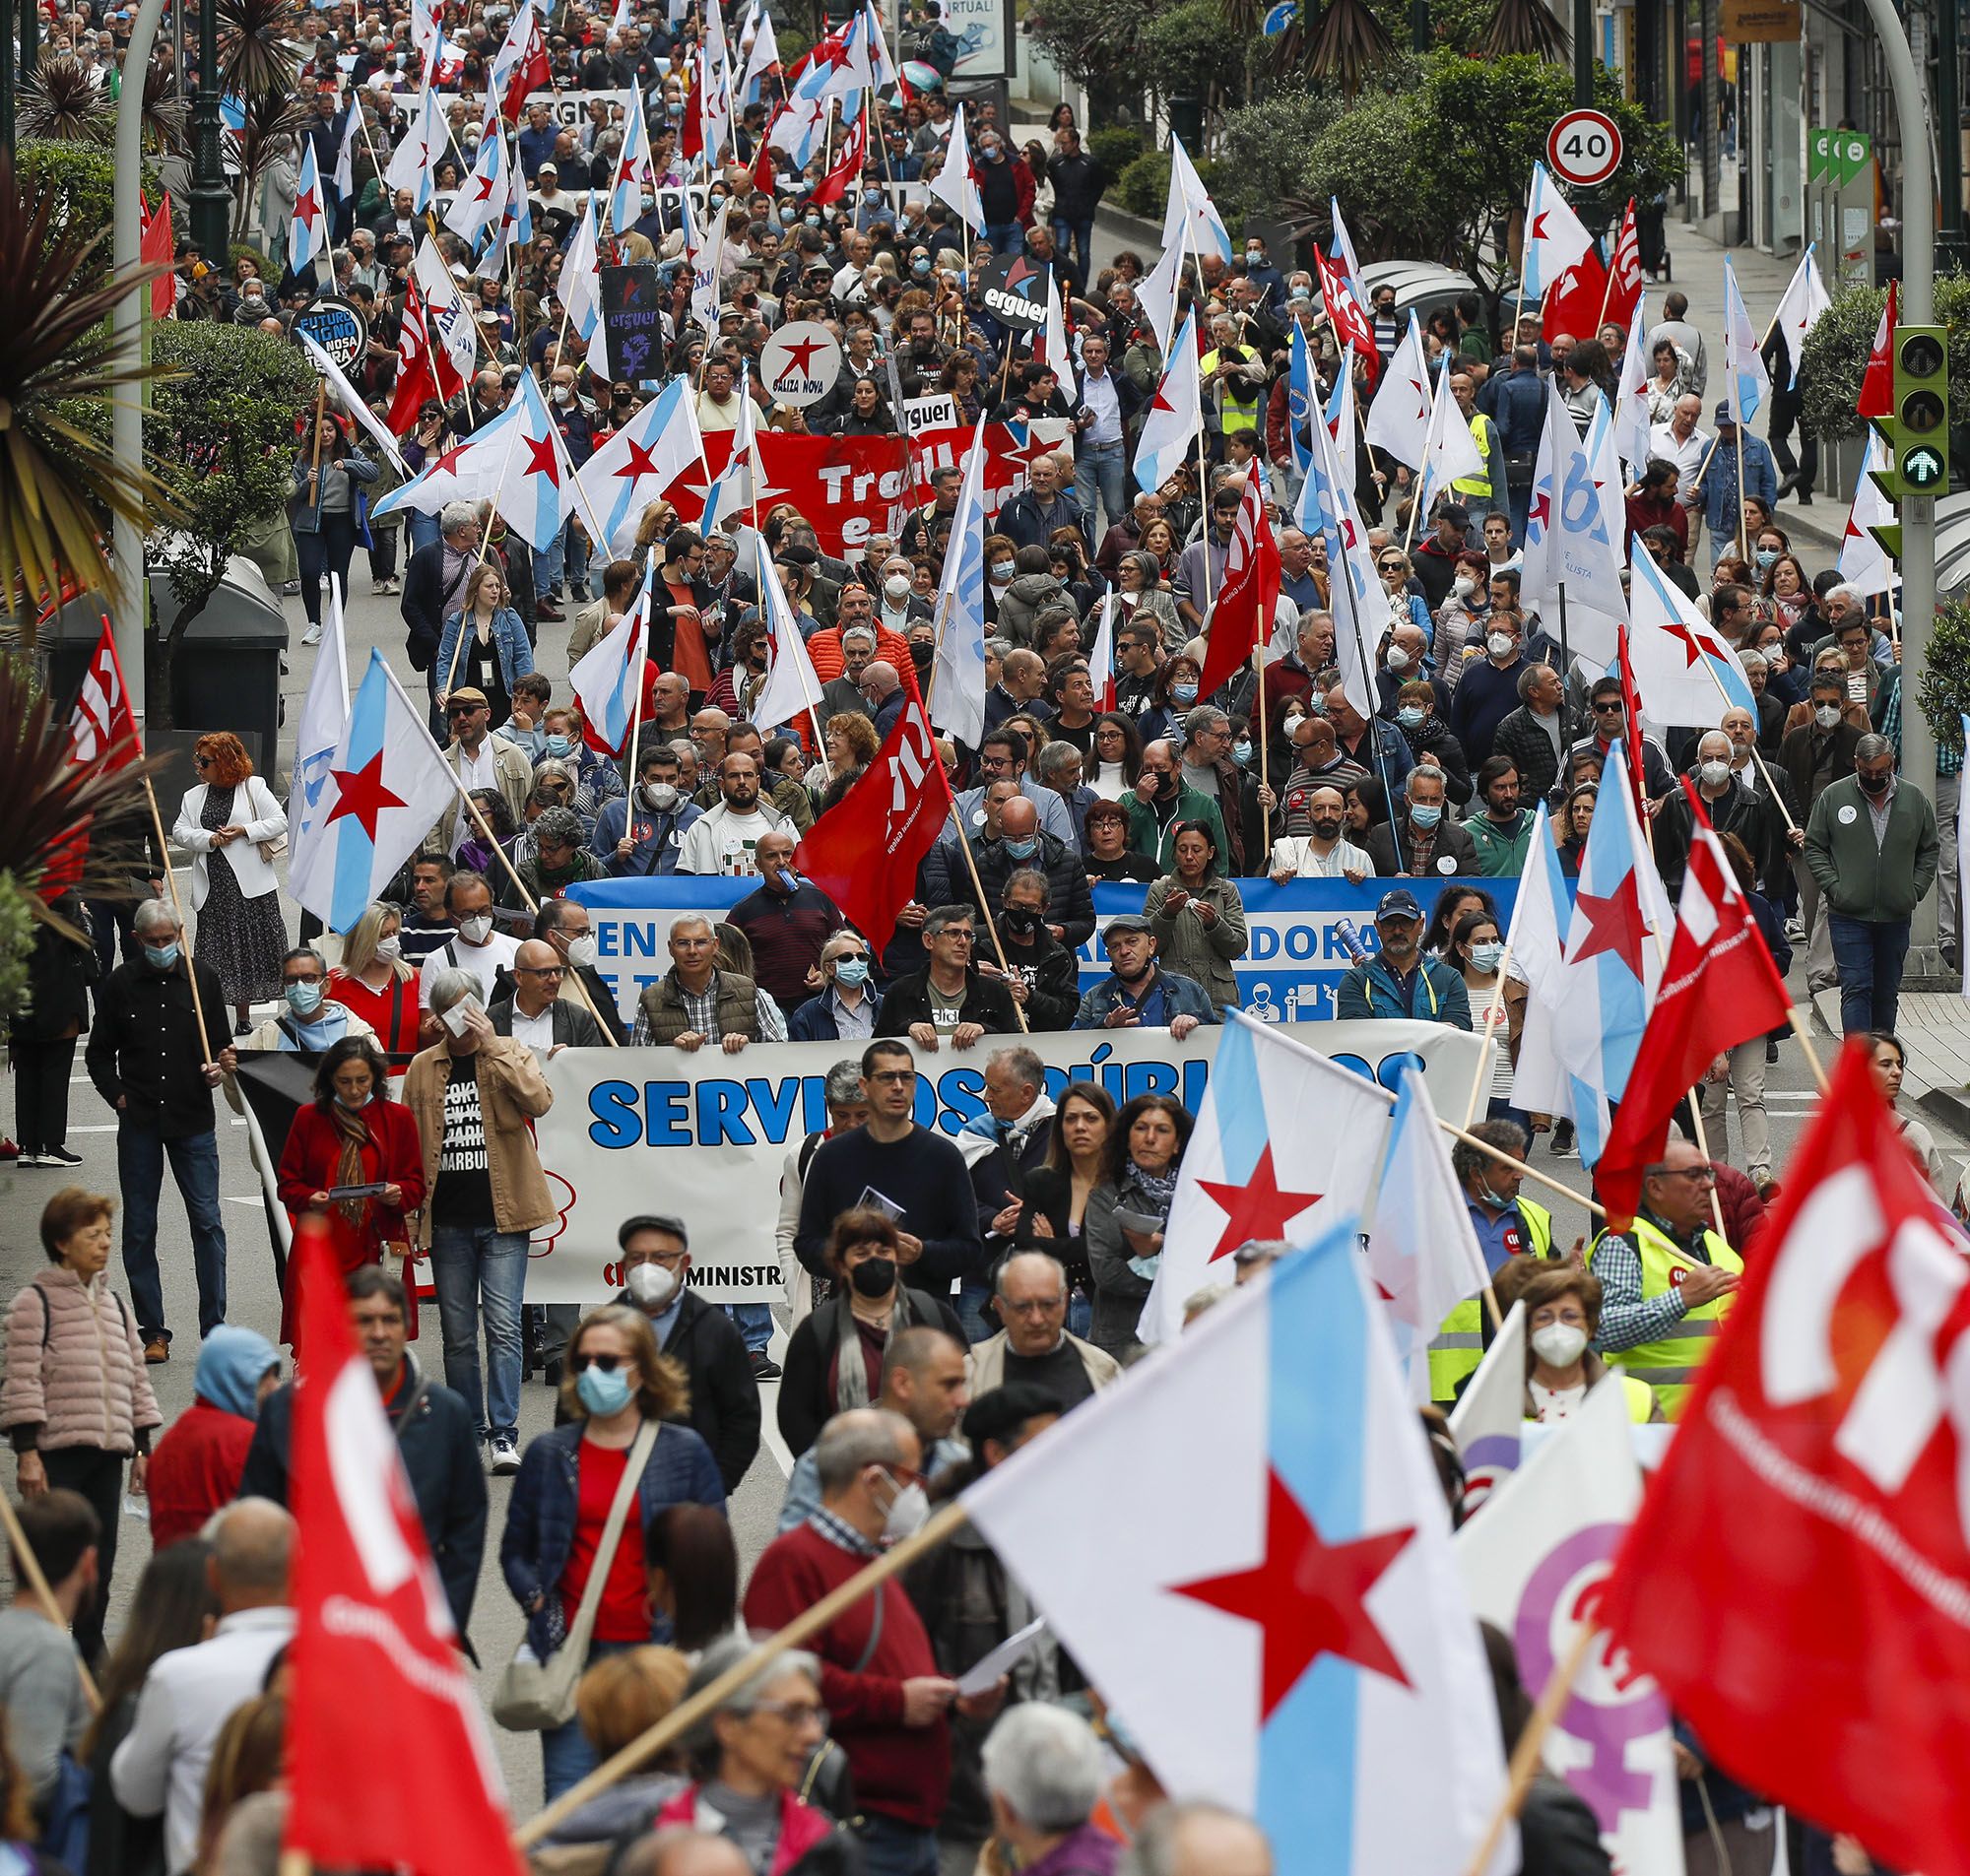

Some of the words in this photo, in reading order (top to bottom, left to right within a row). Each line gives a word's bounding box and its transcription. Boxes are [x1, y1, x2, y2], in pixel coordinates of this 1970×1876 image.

[948, 0, 993, 13] IRTUAL!
[1563, 135, 1607, 158] 40
[984, 288, 1048, 324] erguer
[299, 310, 354, 330] FUTURO
[326, 336, 358, 353] NOSA
[772, 378, 799, 394] GALIZA
[802, 378, 823, 395] NOVA
[906, 402, 952, 430] rguer
[597, 921, 656, 957] EN
[588, 1067, 988, 1149] SERVIOS
